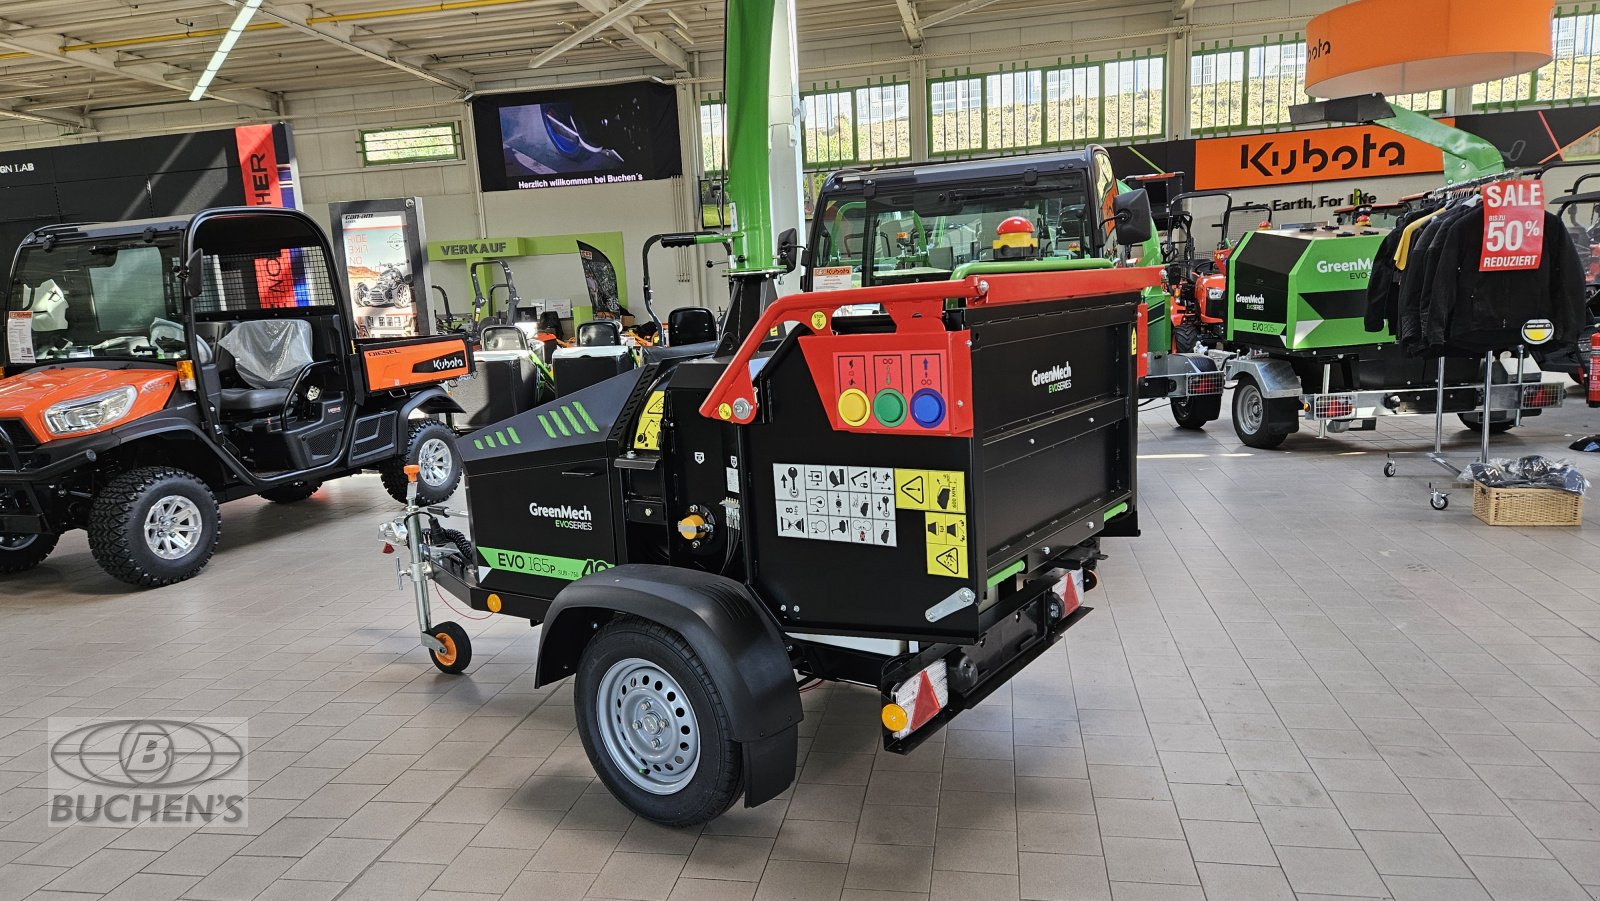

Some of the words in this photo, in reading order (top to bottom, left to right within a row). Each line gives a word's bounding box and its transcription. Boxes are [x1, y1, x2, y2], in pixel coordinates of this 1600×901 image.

[1307, 38, 1331, 63] bota
[1240, 133, 1405, 177] Kubota
[518, 180, 549, 189] Herzlich
[549, 177, 593, 187] willkommen
[594, 175, 606, 184] bei
[1272, 197, 1317, 211] Earth,
[1319, 195, 1344, 208] For
[1486, 183, 1542, 208] SALE
[440, 242, 507, 256] VERKAUF
[1316, 257, 1374, 273] GreenM
[1483, 255, 1538, 268] REDUZIERT
[826, 267, 850, 275] Kubota
[1235, 293, 1265, 305] GreenMech
[1252, 322, 1264, 332] EVO
[368, 349, 401, 358] DIESEL
[433, 356, 464, 370] Kubota
[1031, 360, 1072, 387] GreenMech
[1048, 378, 1072, 394] EVOSERIES
[529, 502, 592, 521] GreenMech
[555, 519, 593, 531] EVOSERIES
[497, 552, 525, 570] EVO
